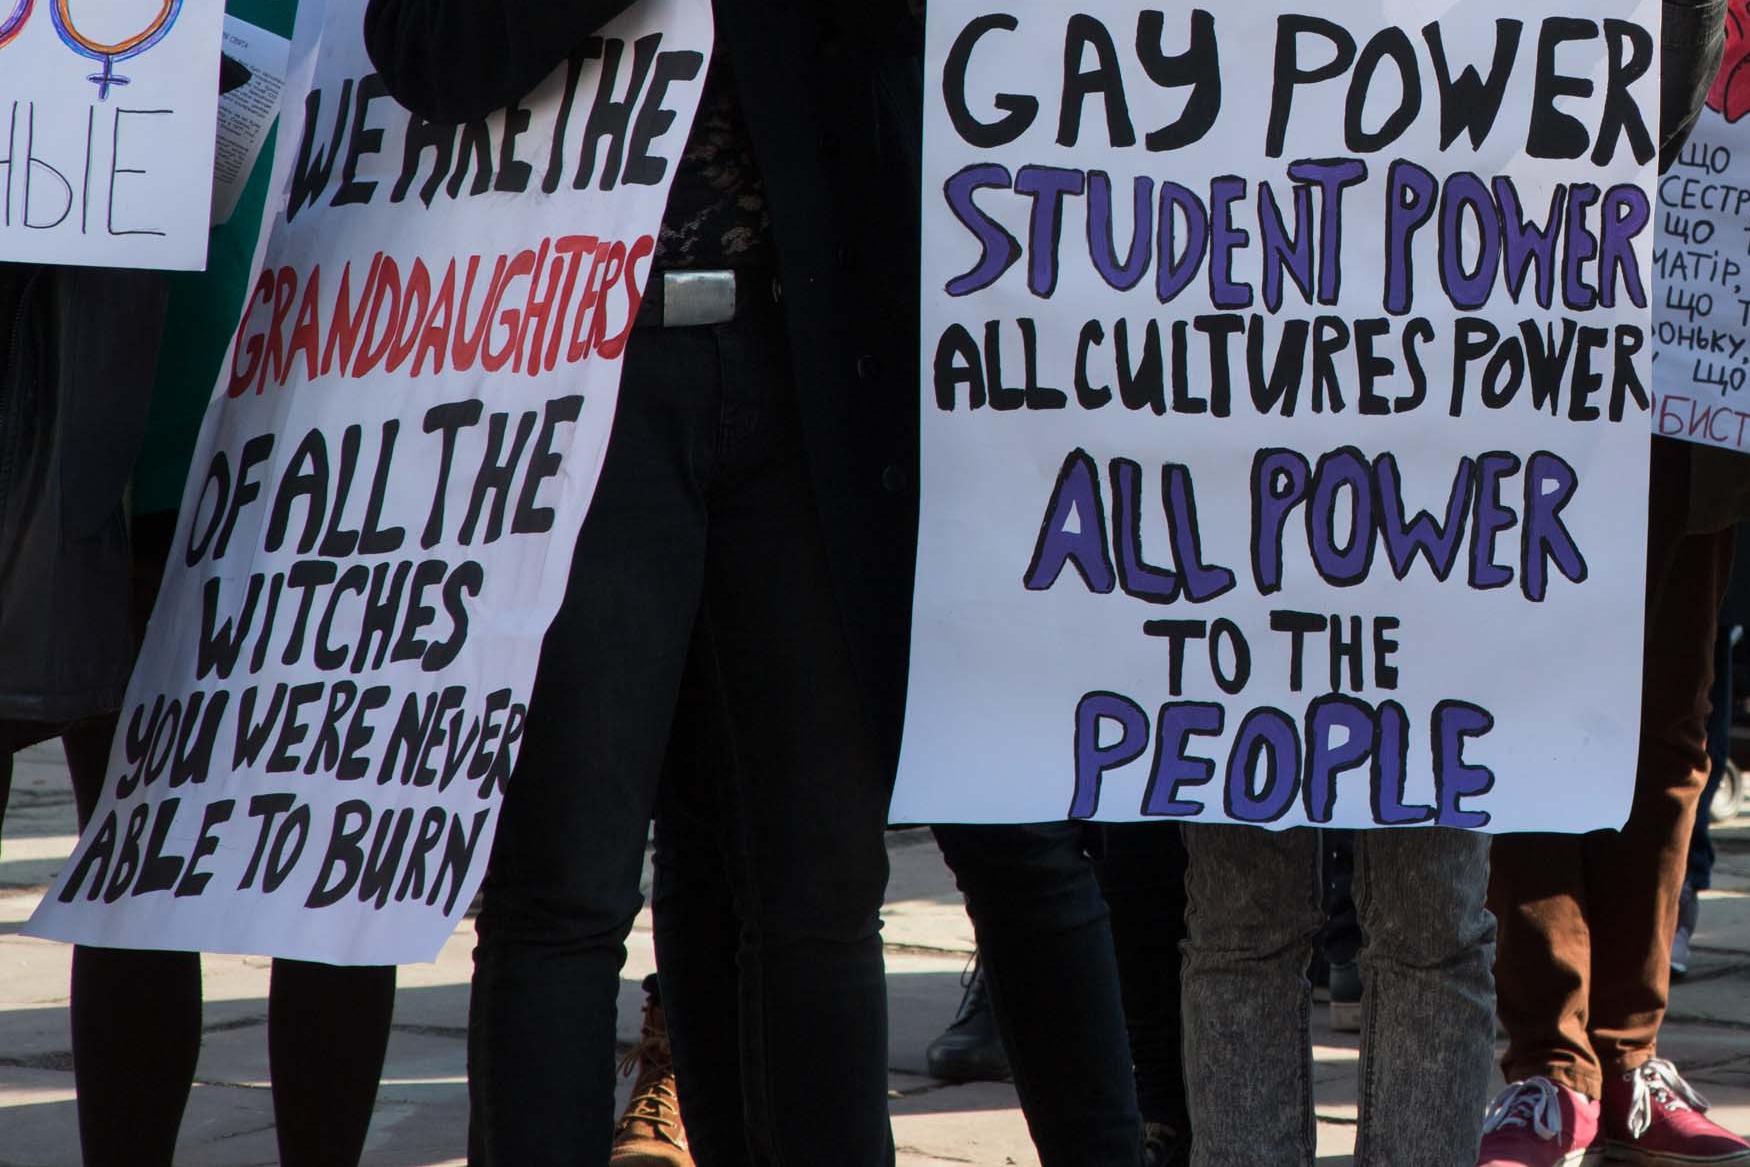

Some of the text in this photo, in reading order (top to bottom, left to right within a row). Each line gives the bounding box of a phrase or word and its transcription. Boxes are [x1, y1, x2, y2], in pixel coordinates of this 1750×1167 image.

[286, 73, 387, 224] WE
[542, 32, 704, 194] THE
[941, 8, 1657, 167] GAY POWER
[1677, 142, 1731, 176] ЩО
[943, 158, 1650, 317] STUDENT POWER
[1664, 210, 1715, 245] ЩО
[226, 234, 655, 399] GRANDDAUGHTERS
[1651, 321, 1750, 365] ОНЬКУ,
[1666, 285, 1713, 322] ЩО
[932, 314, 1650, 423] ALL CULTURES POWER
[1692, 358, 1746, 397] ЩО
[184, 394, 585, 568] OF ALL THE
[1022, 444, 1590, 604] ALL POWER
[195, 560, 485, 681] WITCHES
[1142, 609, 1401, 697] TO THE
[115, 680, 528, 800] YOU WERE NEVER
[1067, 689, 1496, 828] PEOPLE
[57, 792, 491, 917] ABLE TO BURN
